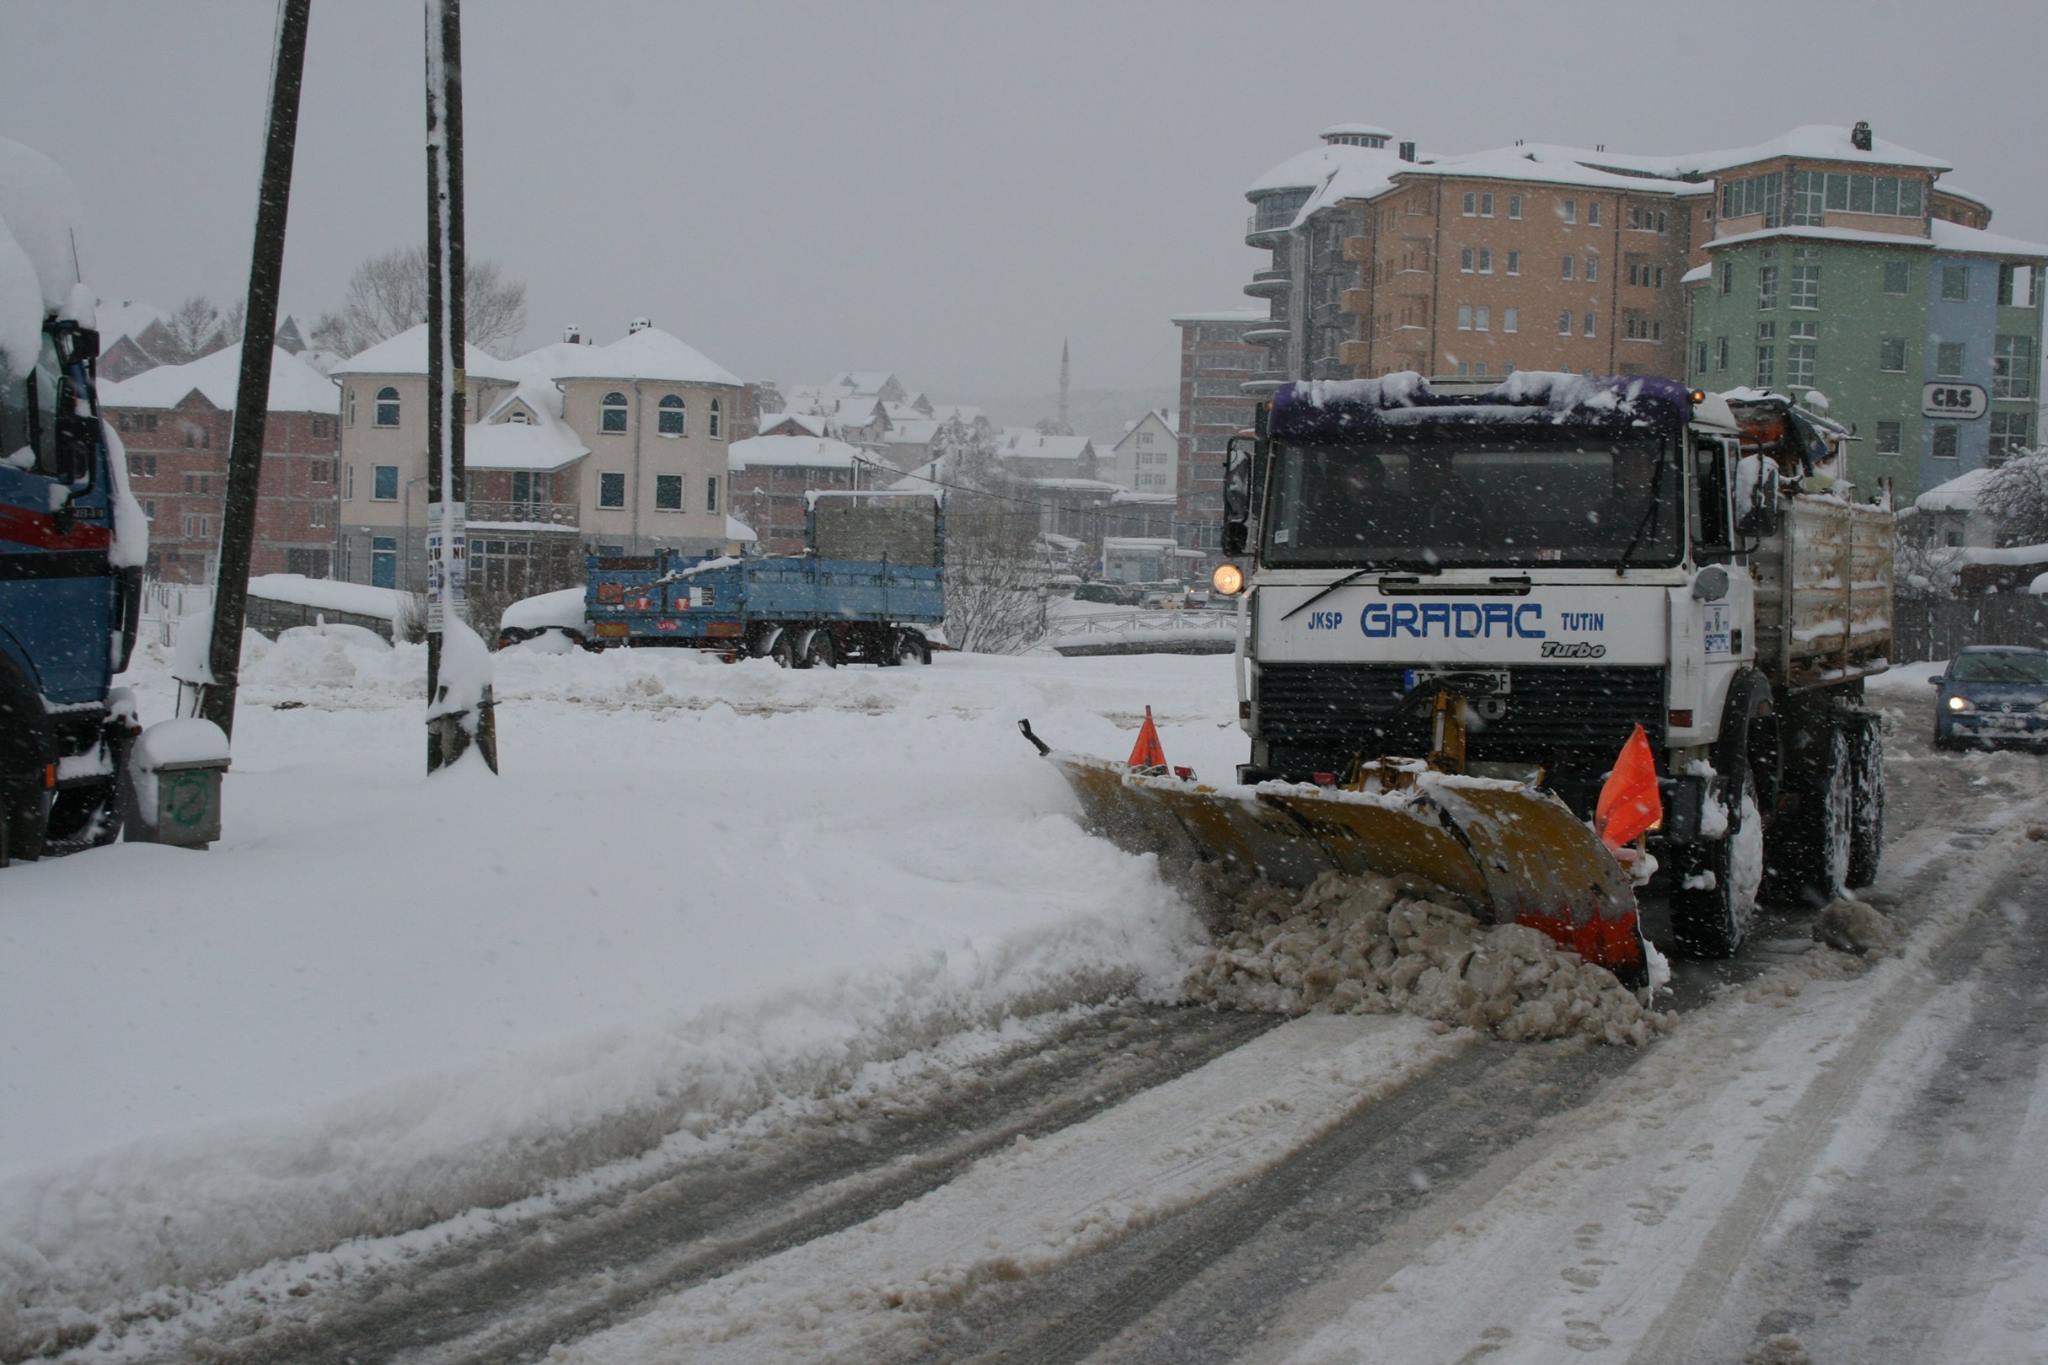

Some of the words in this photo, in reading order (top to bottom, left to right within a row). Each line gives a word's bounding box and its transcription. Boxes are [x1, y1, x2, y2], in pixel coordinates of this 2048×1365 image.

[1932, 388, 1973, 408] CBS
[1308, 611, 1343, 630] JKSP
[1360, 603, 1547, 639] GRADAC
[1541, 642, 1607, 659] Turbo
